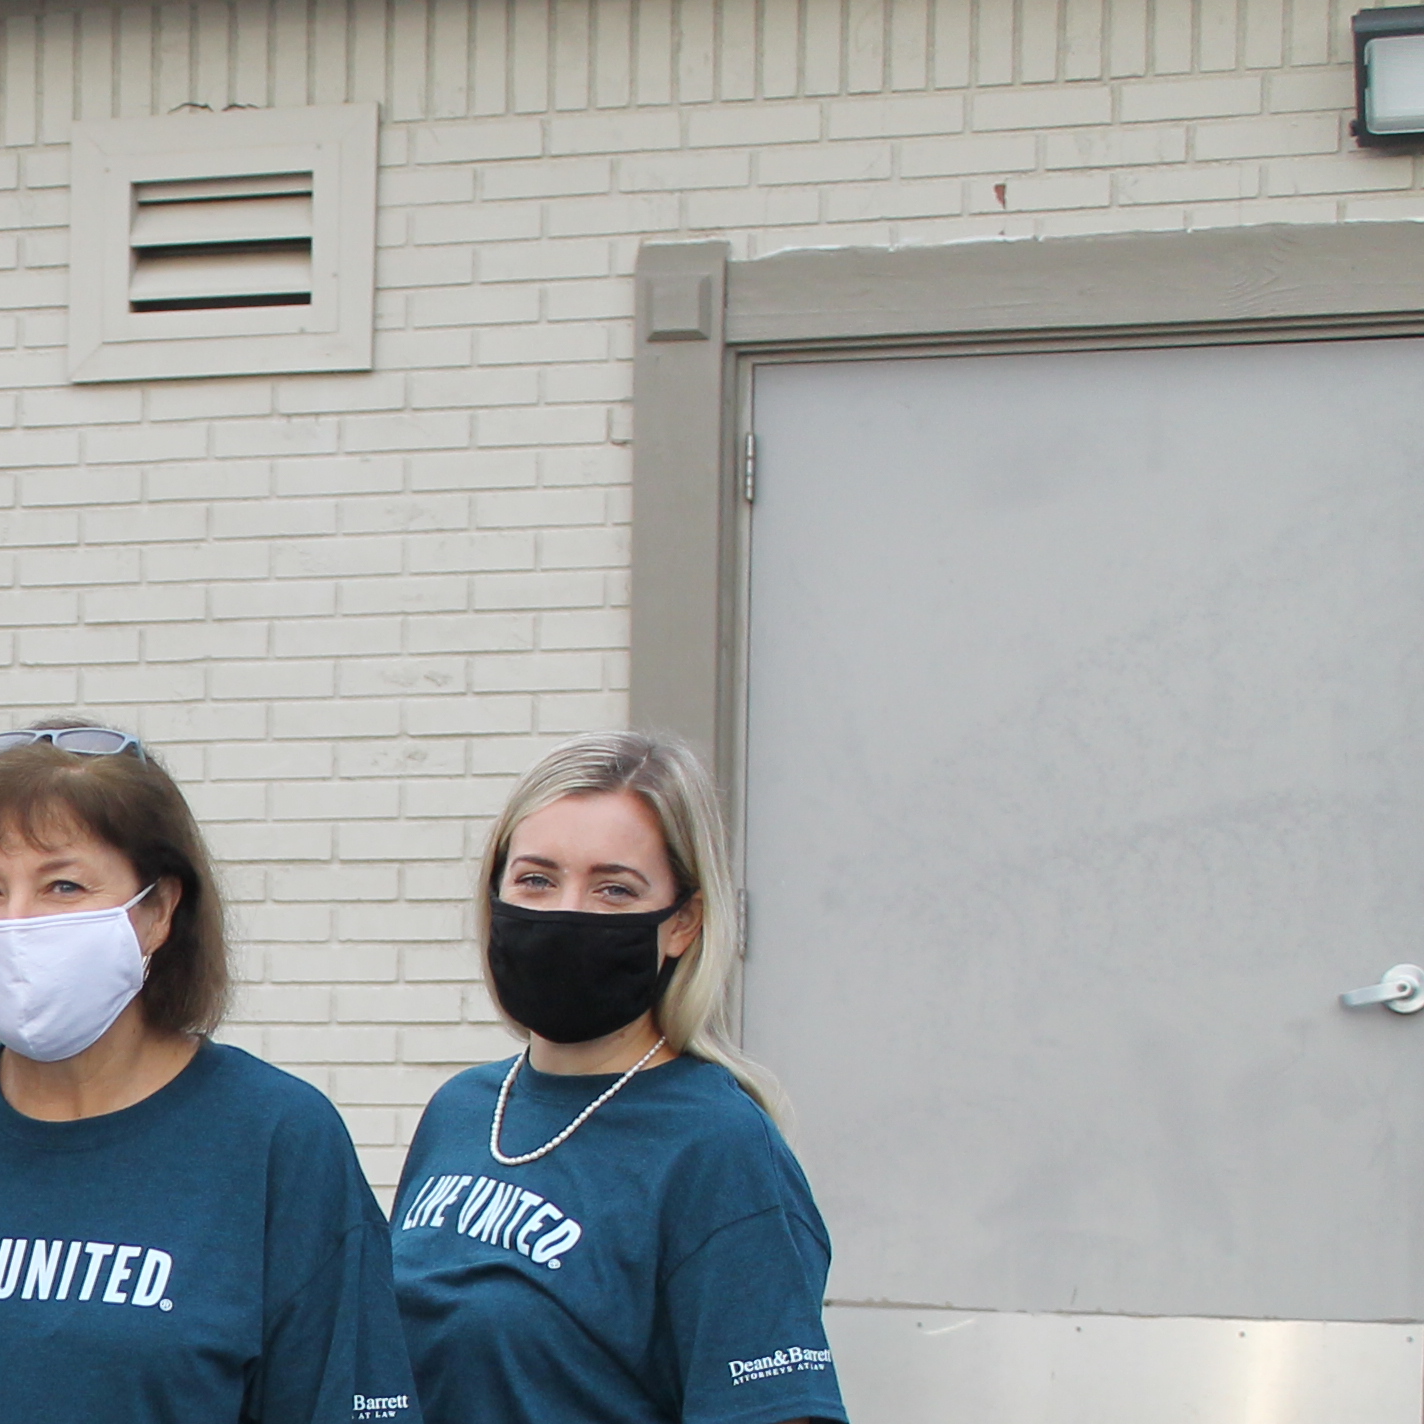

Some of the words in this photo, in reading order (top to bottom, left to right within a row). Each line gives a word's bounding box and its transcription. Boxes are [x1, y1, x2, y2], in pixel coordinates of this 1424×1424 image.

[402, 1175, 473, 1231] LIVE
[733, 1366, 793, 1386] ATTORNEYS
[358, 1411, 371, 1420] AT
[375, 1410, 396, 1419] LAW
